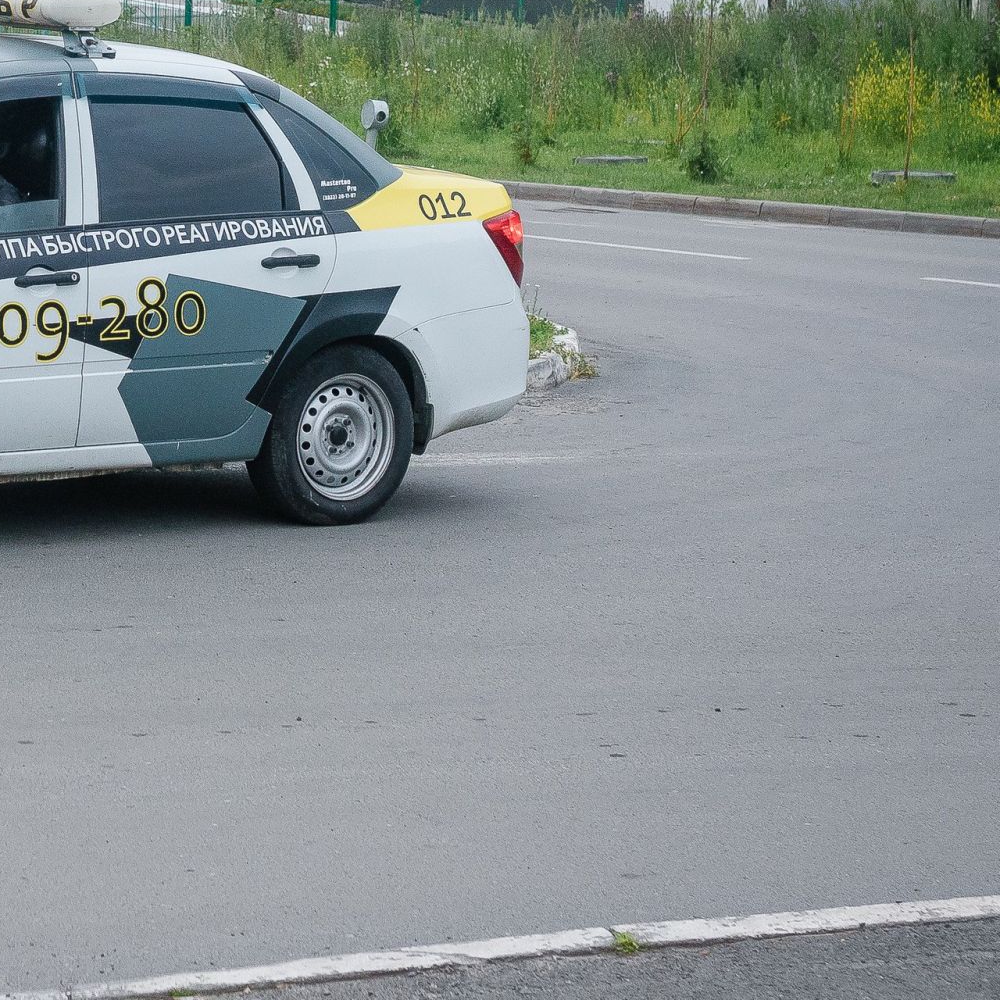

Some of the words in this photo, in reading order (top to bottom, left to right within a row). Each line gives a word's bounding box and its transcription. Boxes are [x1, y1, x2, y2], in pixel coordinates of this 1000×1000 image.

[418, 191, 472, 221] 012
[42, 225, 161, 256] БЫСТРОГО
[162, 215, 328, 245] РЕАГИРОВАНИЯ
